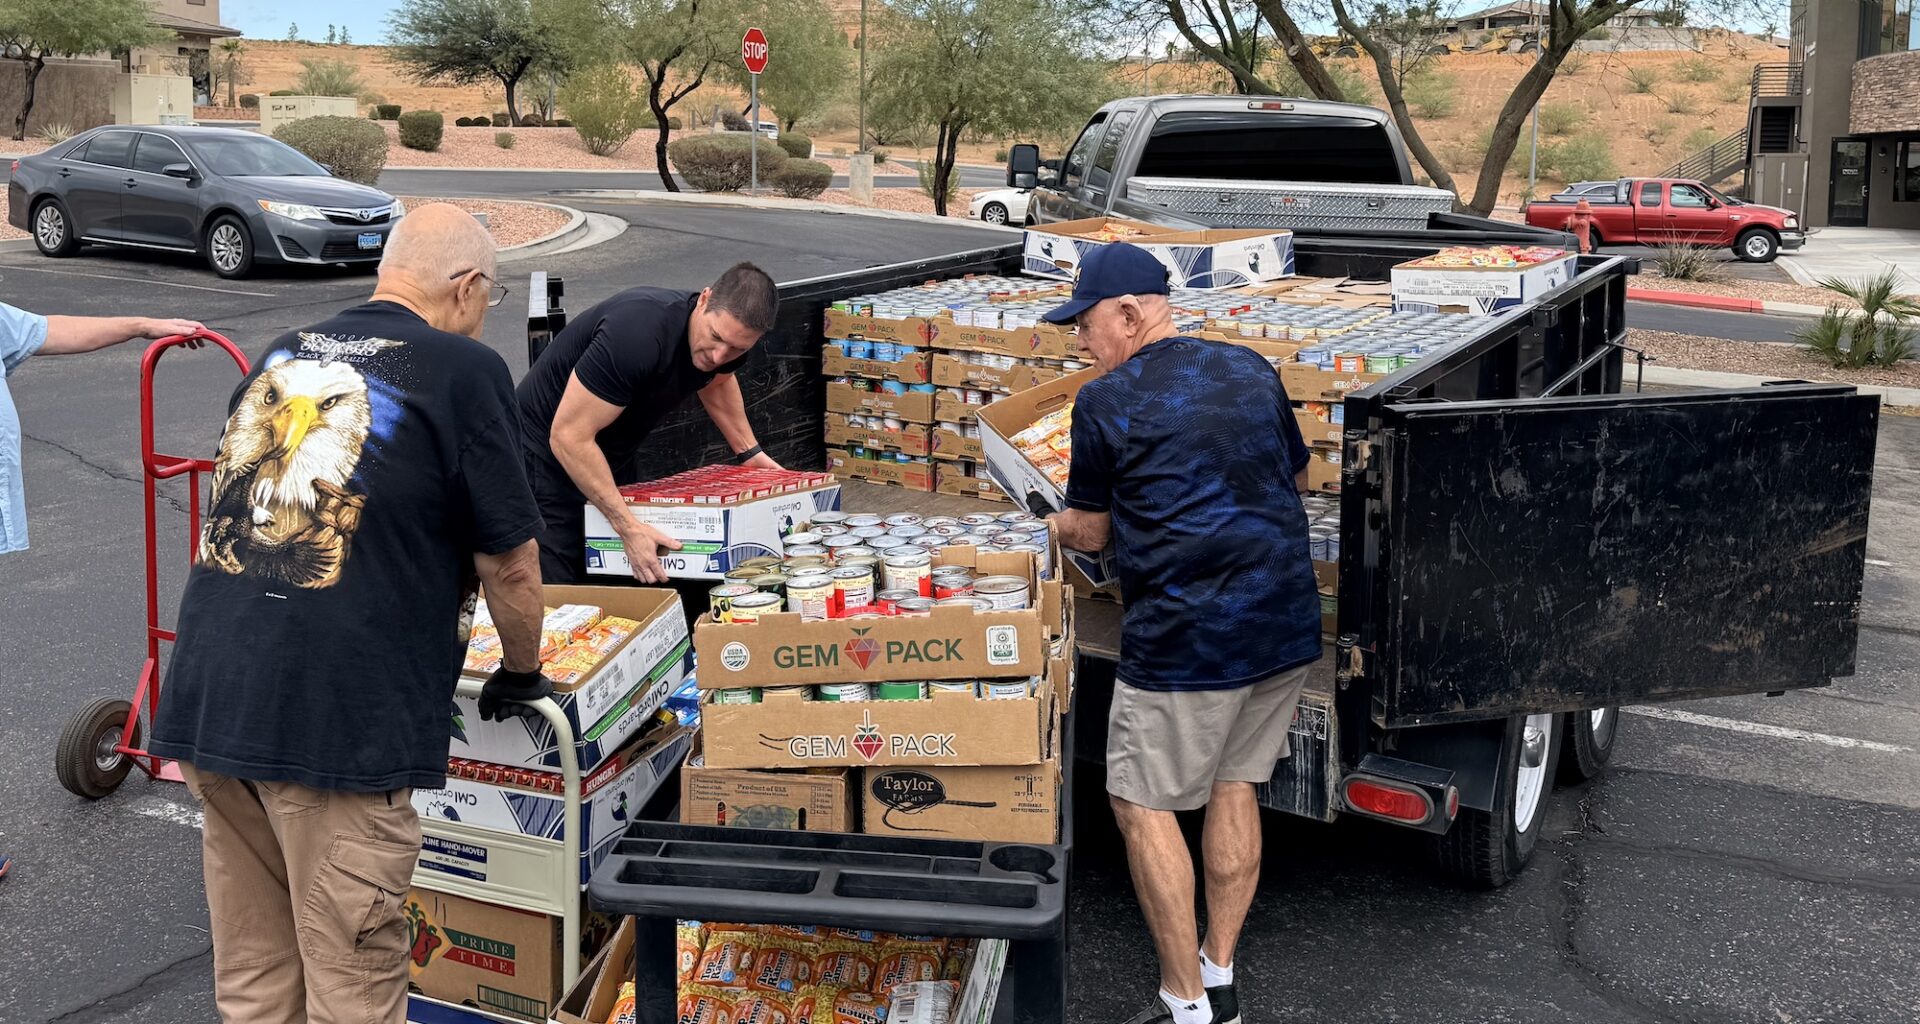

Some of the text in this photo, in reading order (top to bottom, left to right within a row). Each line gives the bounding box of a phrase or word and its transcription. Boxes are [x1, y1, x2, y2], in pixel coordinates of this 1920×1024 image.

[744, 40, 767, 60] STOP
[850, 323, 867, 331] GEM
[959, 332, 1006, 345] GEM PACK
[1064, 343, 1078, 351] GE
[853, 432, 895, 444] GEM PACK
[964, 443, 980, 452] GEM
[855, 465, 899, 478] GEM PACK
[663, 558, 686, 570] CMI
[727, 648, 743, 656] USDA
[774, 638, 964, 669] GEM PACK
[652, 680, 669, 706] CMI
[789, 734, 957, 758] GEM PACK
[585, 763, 617, 793] HUNGRY
[881, 776, 935, 793] Taylor
[737, 783, 766, 792] Product
[454, 792, 477, 806] CMI
[440, 840, 486, 857] HANDI-MOVER
[459, 935, 510, 957] PRIME
[457, 950, 508, 973] TIME
[711, 943, 730, 979] Ramen
[768, 951, 788, 986] Ramen
[700, 961, 717, 981] Top
[756, 965, 774, 985] Top
